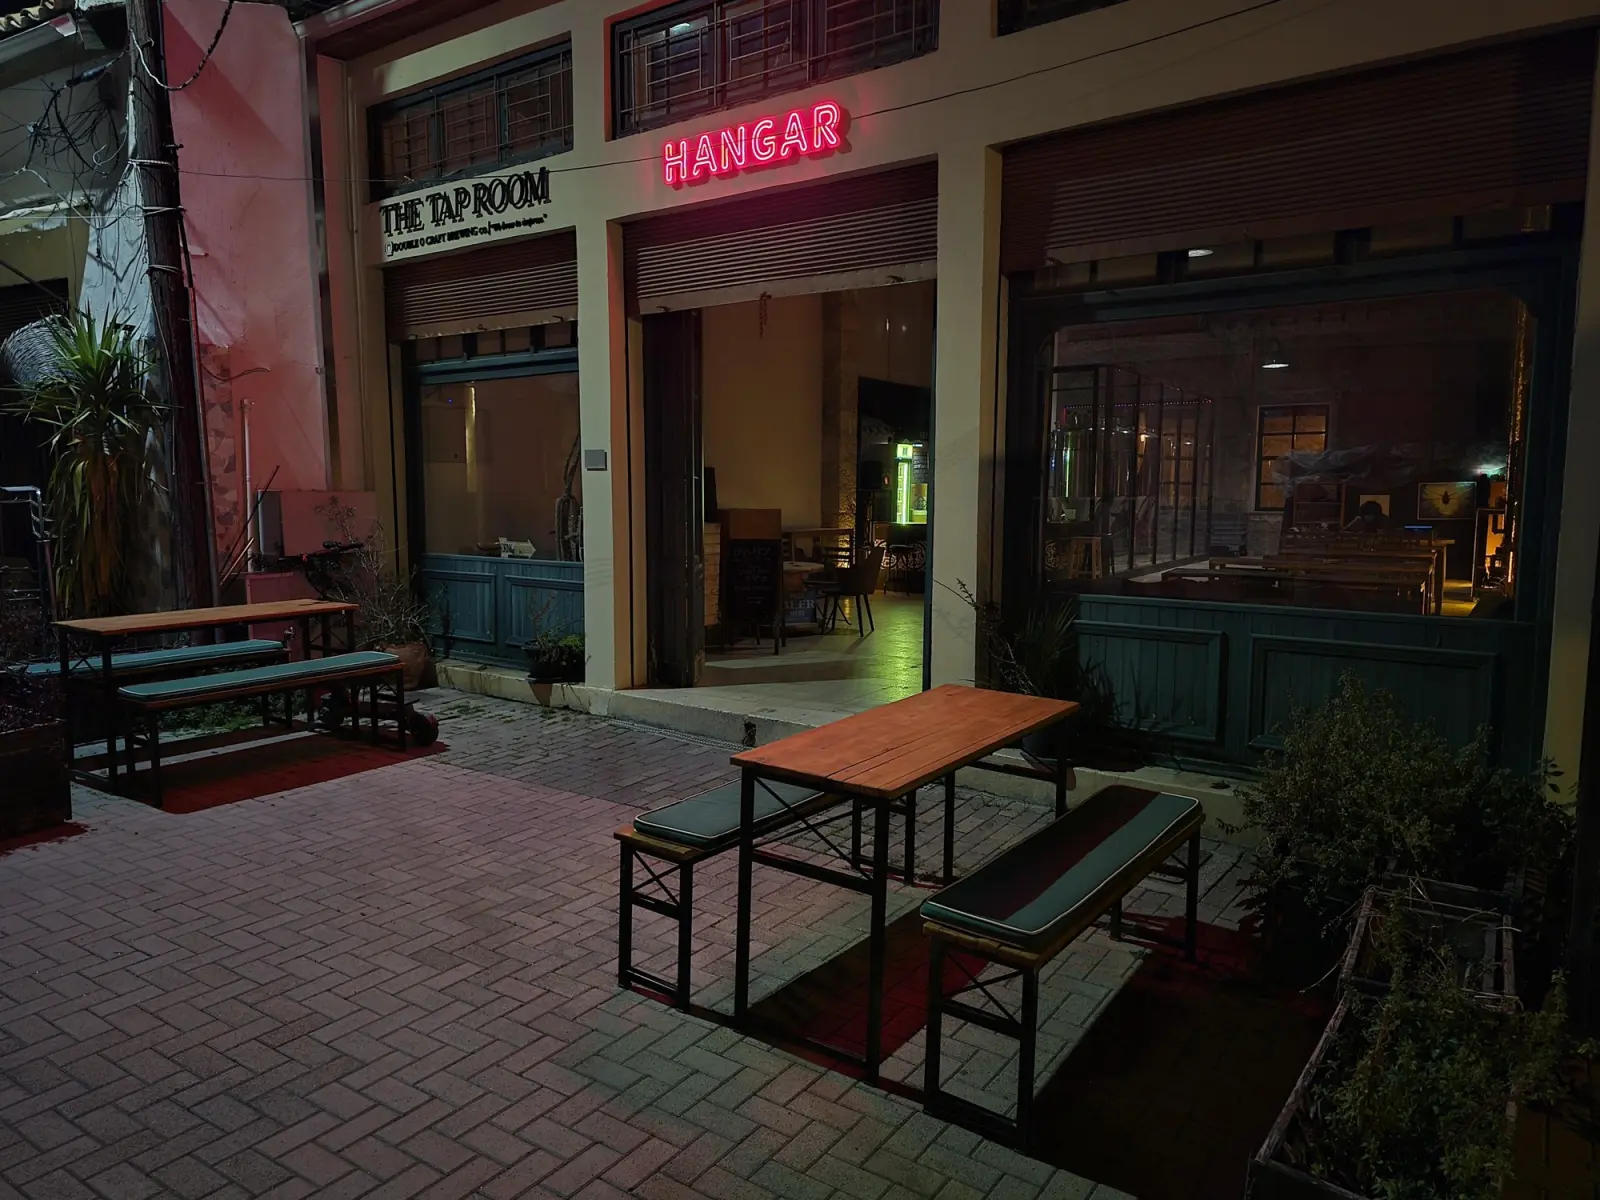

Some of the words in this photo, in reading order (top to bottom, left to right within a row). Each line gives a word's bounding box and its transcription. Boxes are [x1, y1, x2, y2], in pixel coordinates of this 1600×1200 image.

[664, 102, 839, 183] HANGAR
[379, 198, 425, 237] THE
[425, 233, 446, 246] CRAFT
